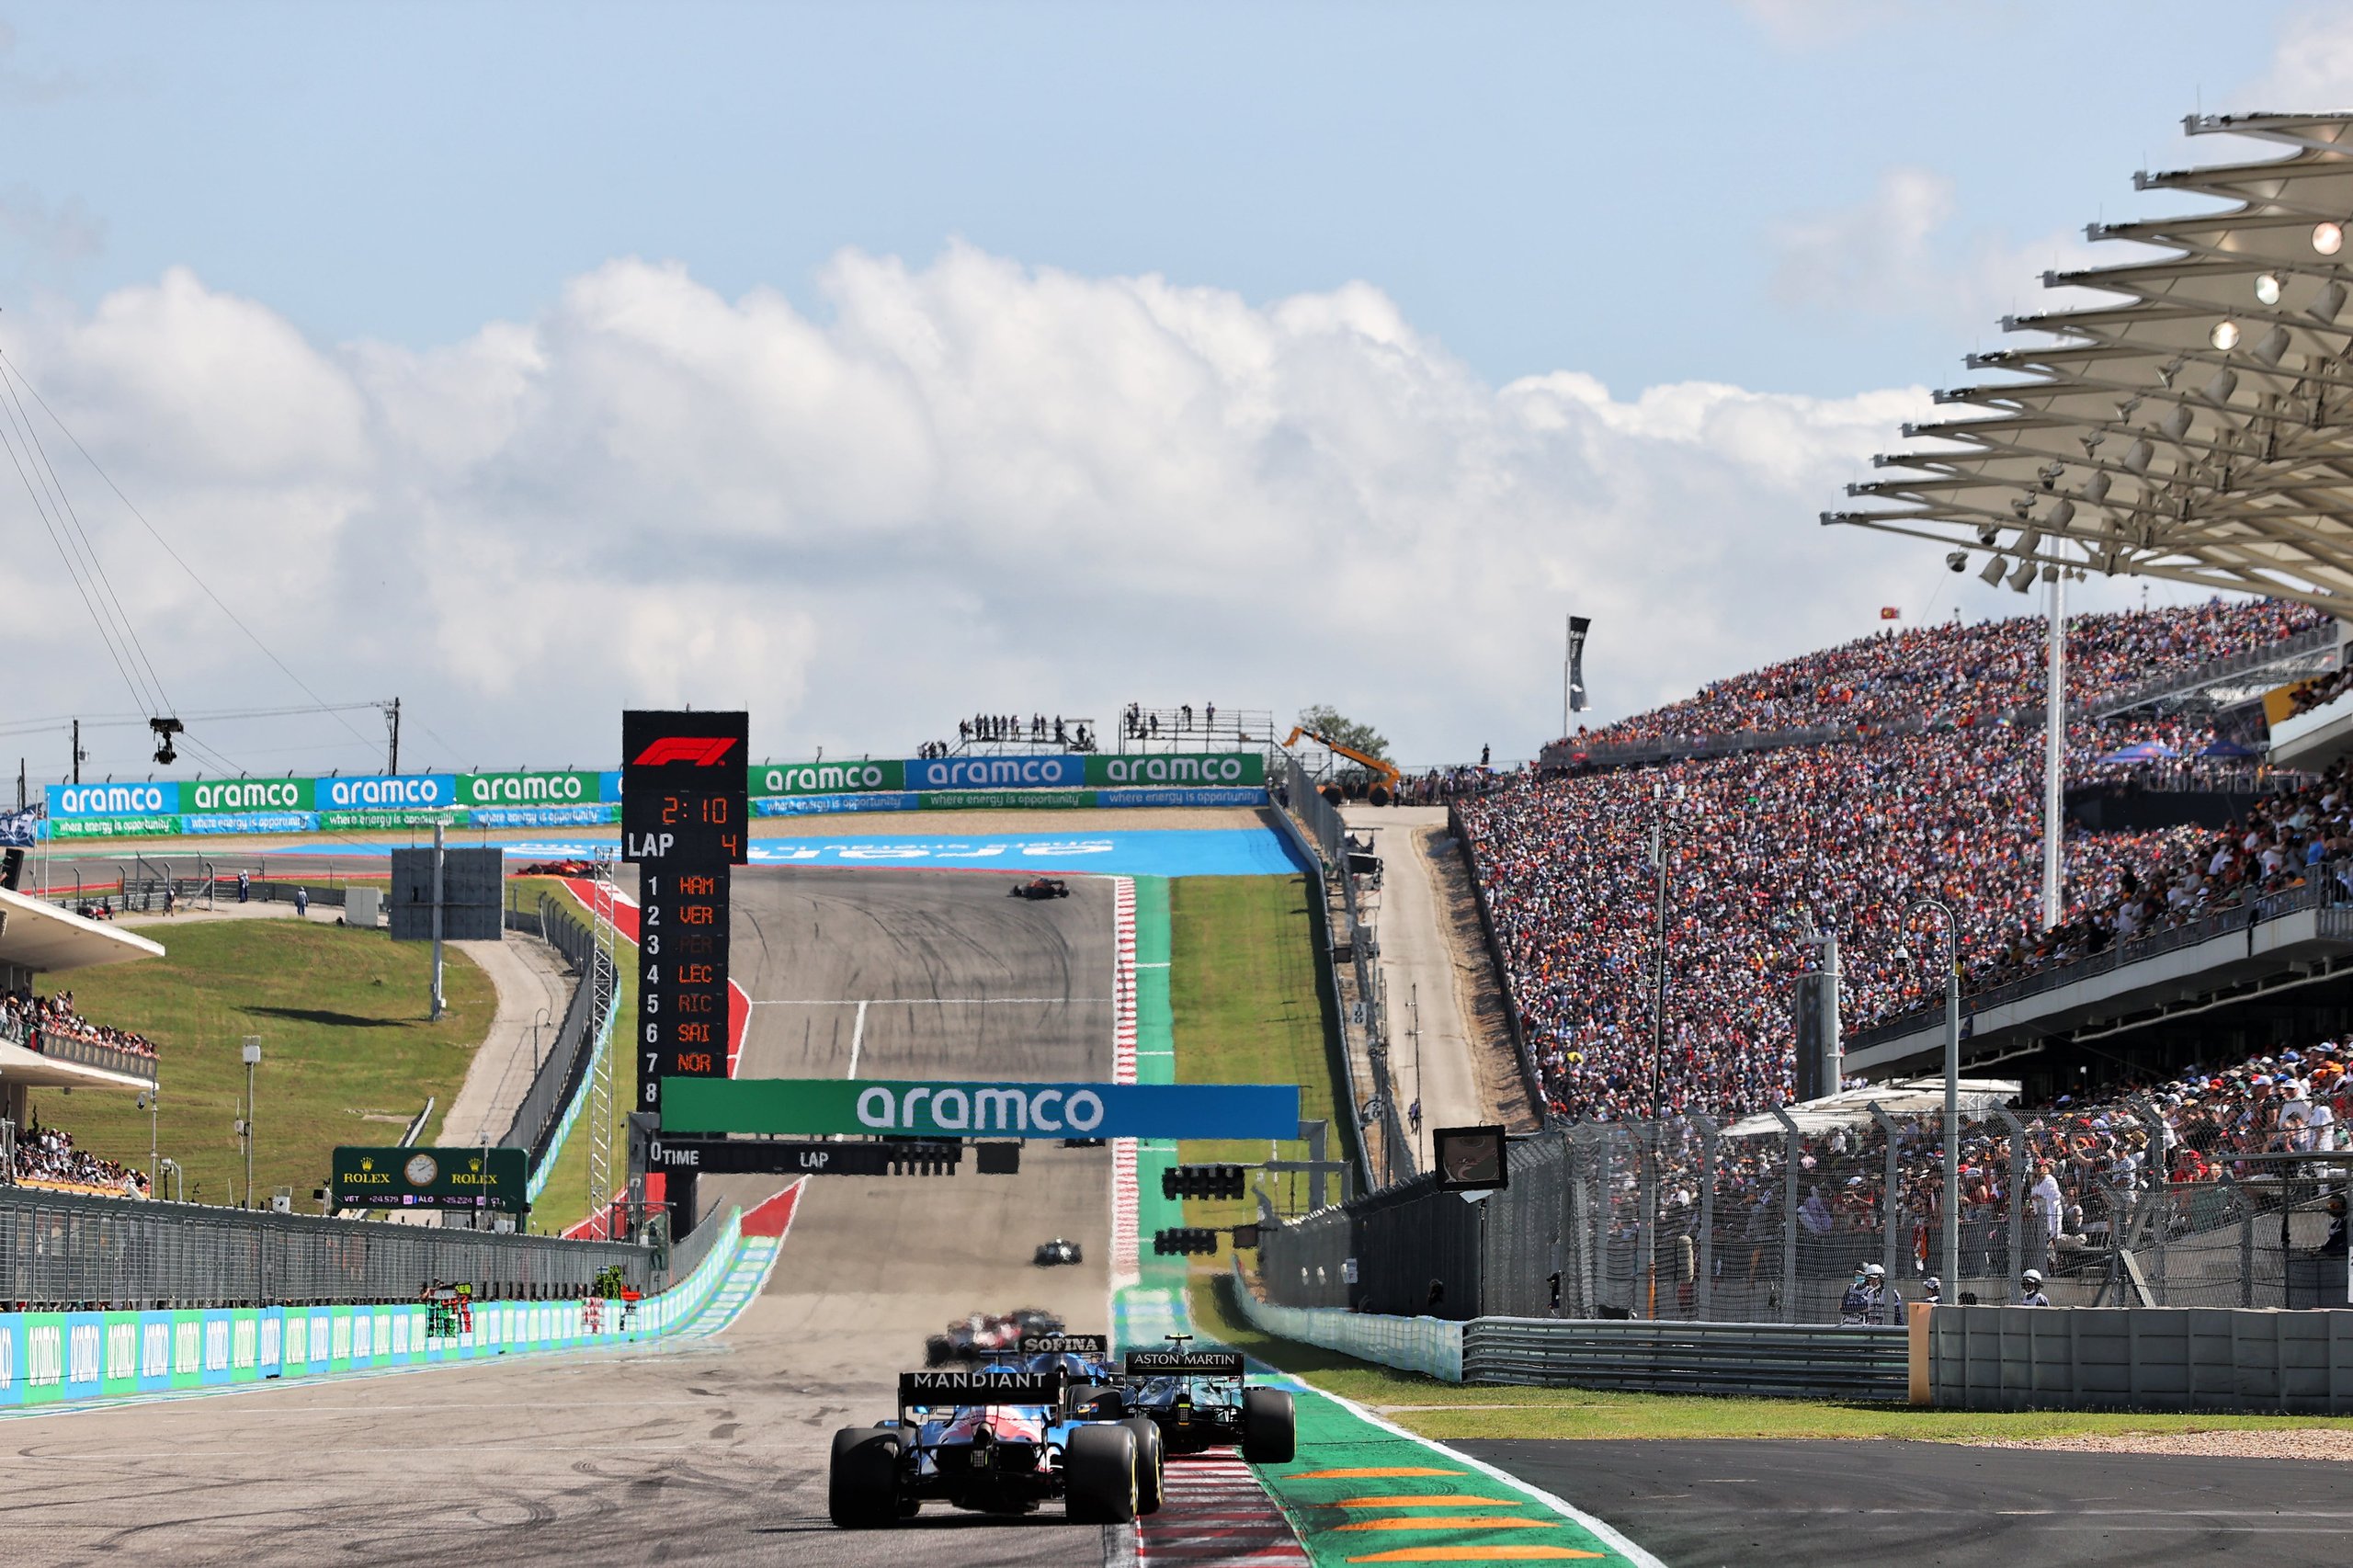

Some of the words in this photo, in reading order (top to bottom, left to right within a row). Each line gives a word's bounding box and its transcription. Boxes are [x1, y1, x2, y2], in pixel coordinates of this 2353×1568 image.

[765, 766, 882, 790] aramco
[927, 760, 1063, 785] aramco
[1107, 757, 1242, 780] aramco
[195, 783, 299, 809] aramco
[331, 779, 438, 805] aramco
[472, 776, 582, 801] aramco
[1109, 791, 1143, 802] where
[1145, 792, 1183, 804] energy
[1186, 790, 1195, 801] is
[1198, 791, 1258, 804] opportunity
[62, 788, 163, 812] aramco
[767, 800, 794, 812] where
[796, 800, 829, 812] energy
[832, 797, 840, 808] is
[843, 796, 901, 810] opportunity
[930, 794, 963, 805] where
[966, 794, 1004, 806] energy
[1006, 793, 1016, 803] is
[1018, 793, 1079, 806] opportunity
[60, 821, 83, 833] where
[84, 821, 112, 835] energy
[114, 819, 122, 831] is
[123, 818, 169, 833] opportunity
[191, 818, 217, 829] where
[218, 818, 248, 830] energy
[249, 817, 257, 827] is
[330, 814, 358, 824] where
[359, 814, 392, 827] energy
[393, 813, 401, 824] is
[478, 812, 505, 823] where
[507, 812, 537, 824] energy
[539, 811, 547, 822] is
[548, 809, 597, 824] opportunity
[628, 833, 675, 858] LAP
[722, 835, 737, 858] 4
[648, 876, 657, 896] 1
[679, 875, 715, 895] HAM
[647, 905, 660, 926] 2
[679, 905, 714, 925] VER
[647, 935, 660, 955] 3
[646, 964, 659, 984] 4
[678, 964, 712, 983] LEC
[647, 994, 659, 1014] 5
[678, 994, 711, 1013] RIC
[646, 1023, 658, 1043] 6
[677, 1023, 710, 1042] SAI
[646, 1052, 658, 1074] 7
[677, 1053, 711, 1073] NOR
[645, 1084, 658, 1102] 8
[857, 1086, 1104, 1131] aramco
[662, 1149, 699, 1165] TIME
[800, 1152, 829, 1168] LAP
[343, 1173, 390, 1184] ROLEX
[451, 1174, 498, 1185] ROLEX
[1024, 1337, 1098, 1352] SOFINA
[1134, 1354, 1180, 1365] ASTON
[1183, 1354, 1235, 1365] MARTIN
[914, 1373, 1047, 1388] MANDIANT
